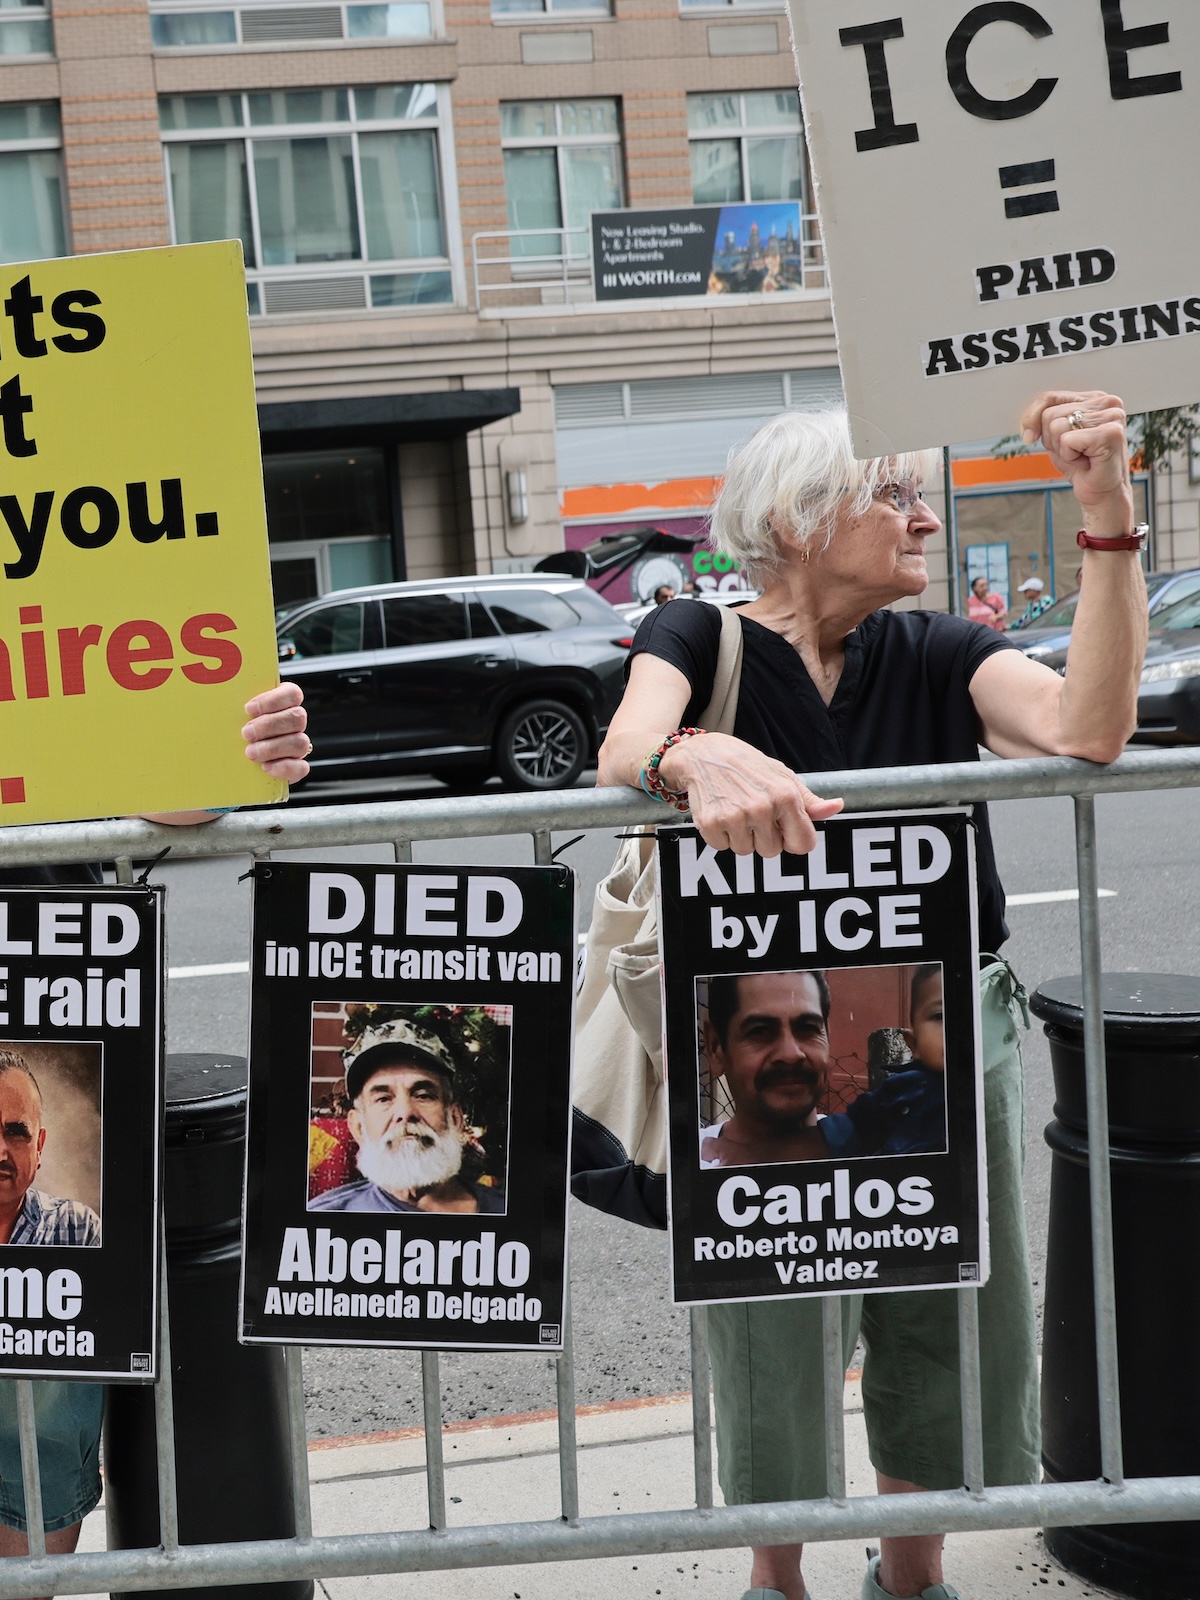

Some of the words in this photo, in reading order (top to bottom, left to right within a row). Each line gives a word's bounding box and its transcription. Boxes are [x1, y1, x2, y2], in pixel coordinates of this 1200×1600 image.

[839, 0, 1182, 152] ICE
[999, 159, 1059, 218] =
[603, 251, 664, 265] Apartments
[976, 248, 1115, 302] PAID
[679, 825, 951, 897] KILLED
[309, 873, 523, 937] DIED
[711, 907, 779, 957] by
[799, 894, 922, 952] ICE
[266, 941, 299, 976] in
[309, 942, 362, 978] ICE
[371, 945, 490, 980] transit
[498, 952, 561, 981] van
[24, 968, 140, 1027] raid
[717, 1169, 934, 1227] Carlos
[278, 1228, 530, 1287] Abelardo
[694, 1232, 817, 1261] Roberto
[827, 1224, 958, 1251] Montoya
[775, 1257, 878, 1284] Valdez
[264, 1287, 420, 1318] Avellaneda
[427, 1291, 541, 1323] Delgado
